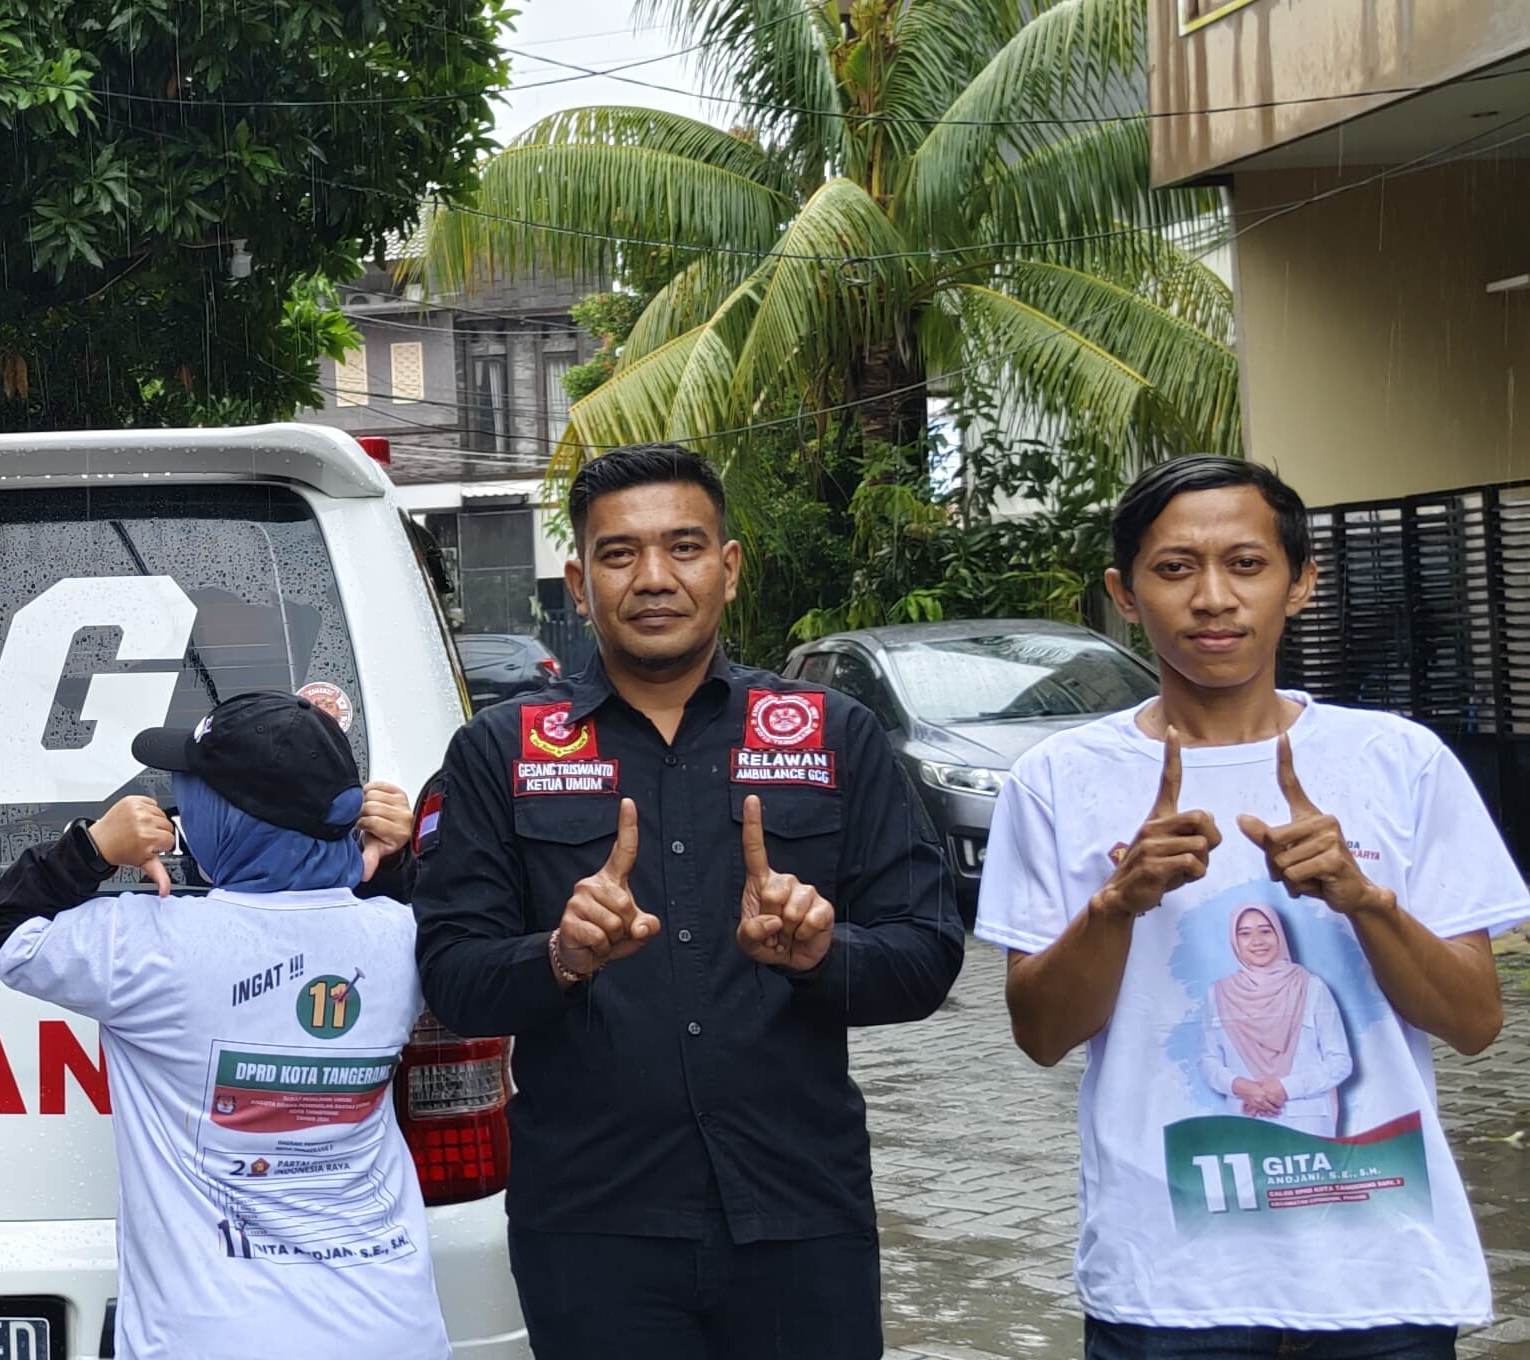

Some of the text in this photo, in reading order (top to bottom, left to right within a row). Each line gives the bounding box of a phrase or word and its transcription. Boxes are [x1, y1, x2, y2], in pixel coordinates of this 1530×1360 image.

[738, 752, 828, 766] RELAWAN
[518, 763, 614, 777] GESANG TRISWANTO
[736, 769, 830, 784] AMBULANCE GCG
[526, 777, 603, 791] KETUA UMUM
[1347, 841, 1360, 849] DA
[1350, 850, 1380, 860] KARYA
[232, 953, 304, 1007] INGAT !!!
[309, 981, 350, 1029] 11
[236, 1063, 276, 1082] DPRD
[280, 1065, 318, 1085] KOTA
[229, 1160, 246, 1176] 2
[274, 1162, 351, 1175] INDONESIA RAYA
[1262, 1152, 1332, 1176] GITA
[1192, 1153, 1258, 1213] 11
